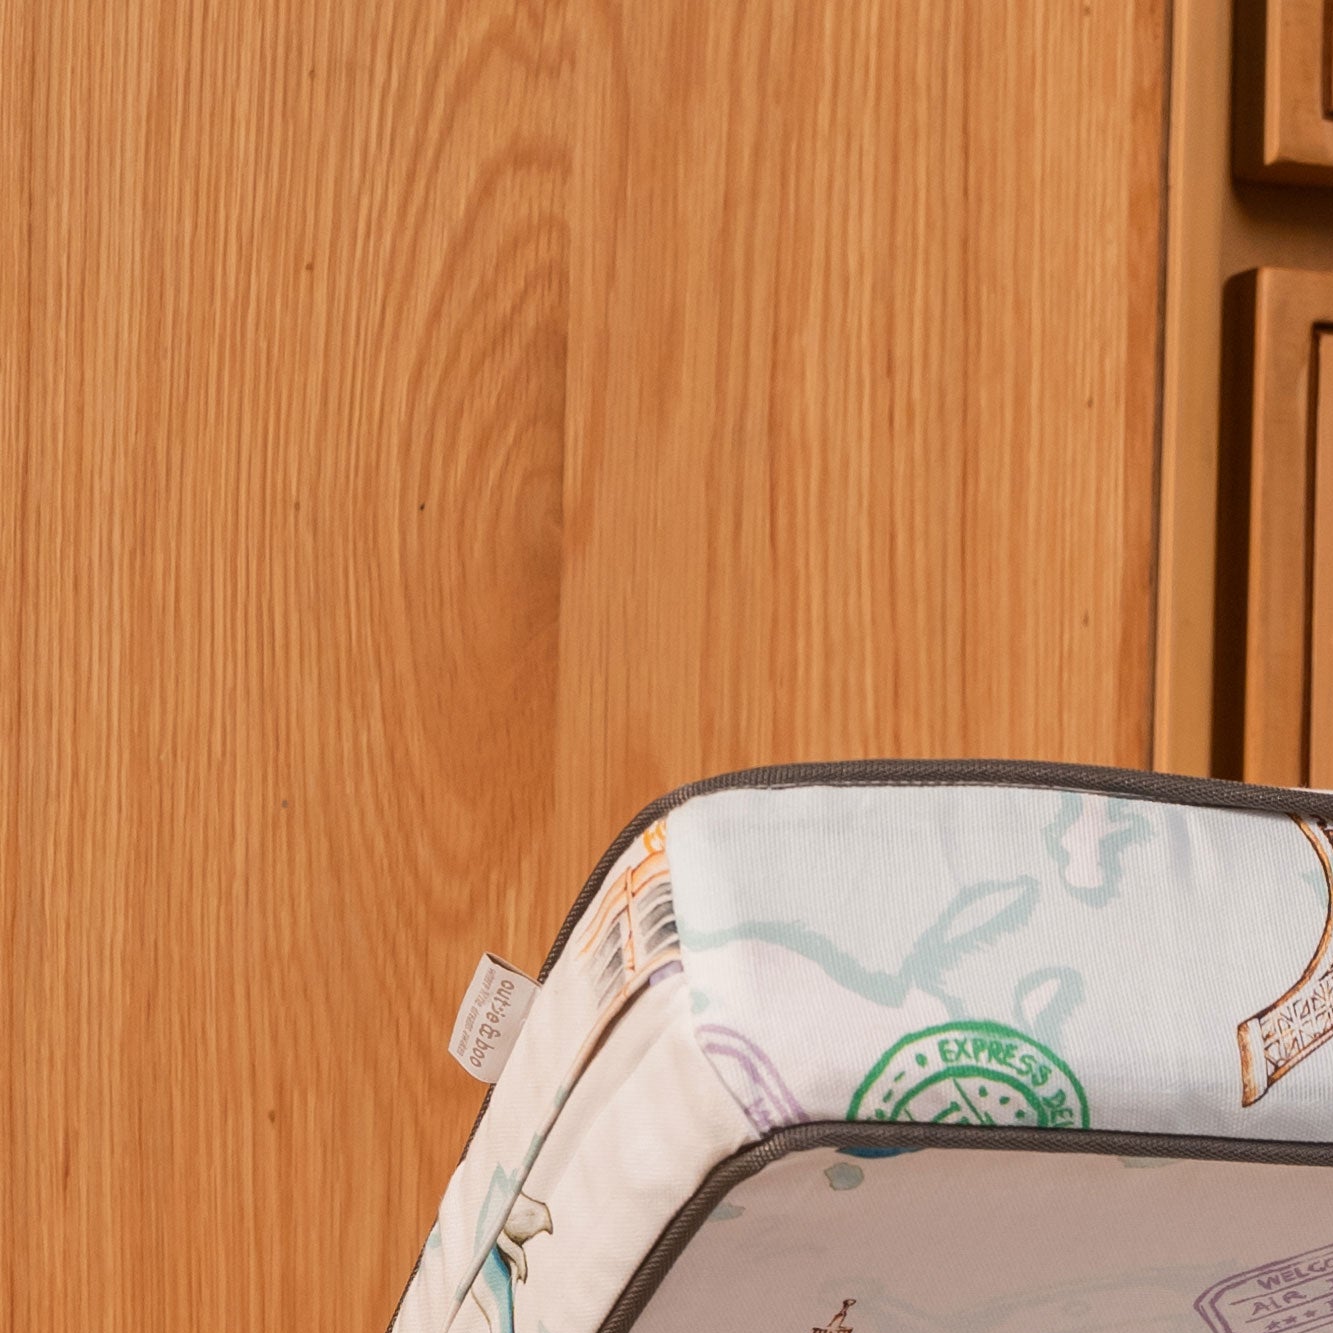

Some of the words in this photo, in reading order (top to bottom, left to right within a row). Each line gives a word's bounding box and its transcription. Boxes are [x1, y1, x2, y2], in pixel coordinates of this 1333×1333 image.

[469, 1038, 494, 1068] boo
[937, 1037, 1052, 1087] EXPRESS
[1250, 1290, 1308, 1316] AIR
